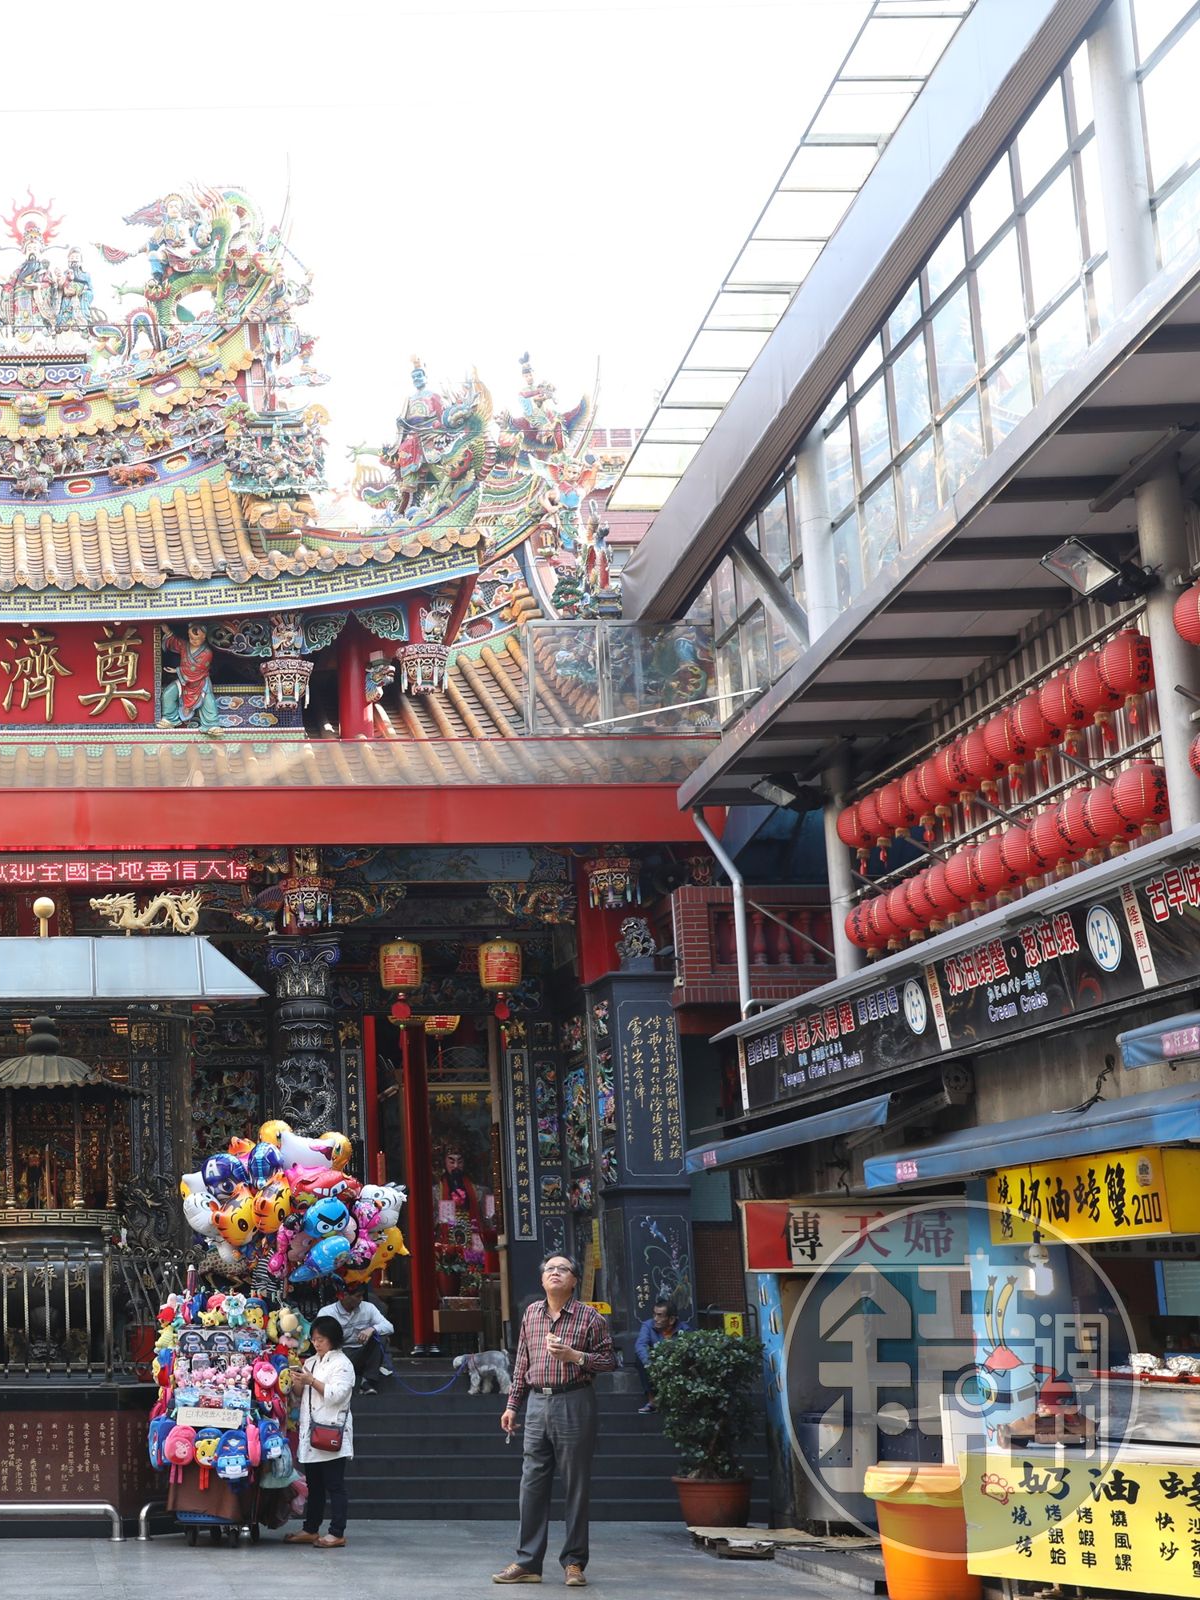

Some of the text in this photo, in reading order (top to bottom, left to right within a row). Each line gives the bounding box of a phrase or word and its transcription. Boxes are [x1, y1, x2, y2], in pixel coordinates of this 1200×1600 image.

[1091, 916, 1117, 960] 25-4
[987, 991, 1049, 1023] Cream Crabs
[1018, 1162, 1131, 1228] 奶油螃蟹
[1131, 1192, 1163, 1225] 200
[1011, 1505, 1034, 1559] 燒烤
[1045, 1503, 1067, 1565] 烤銀蛤
[1076, 1506, 1098, 1569] 烤蝦串
[1110, 1509, 1133, 1572] 燒風螺
[1155, 1511, 1179, 1561] 快炒
